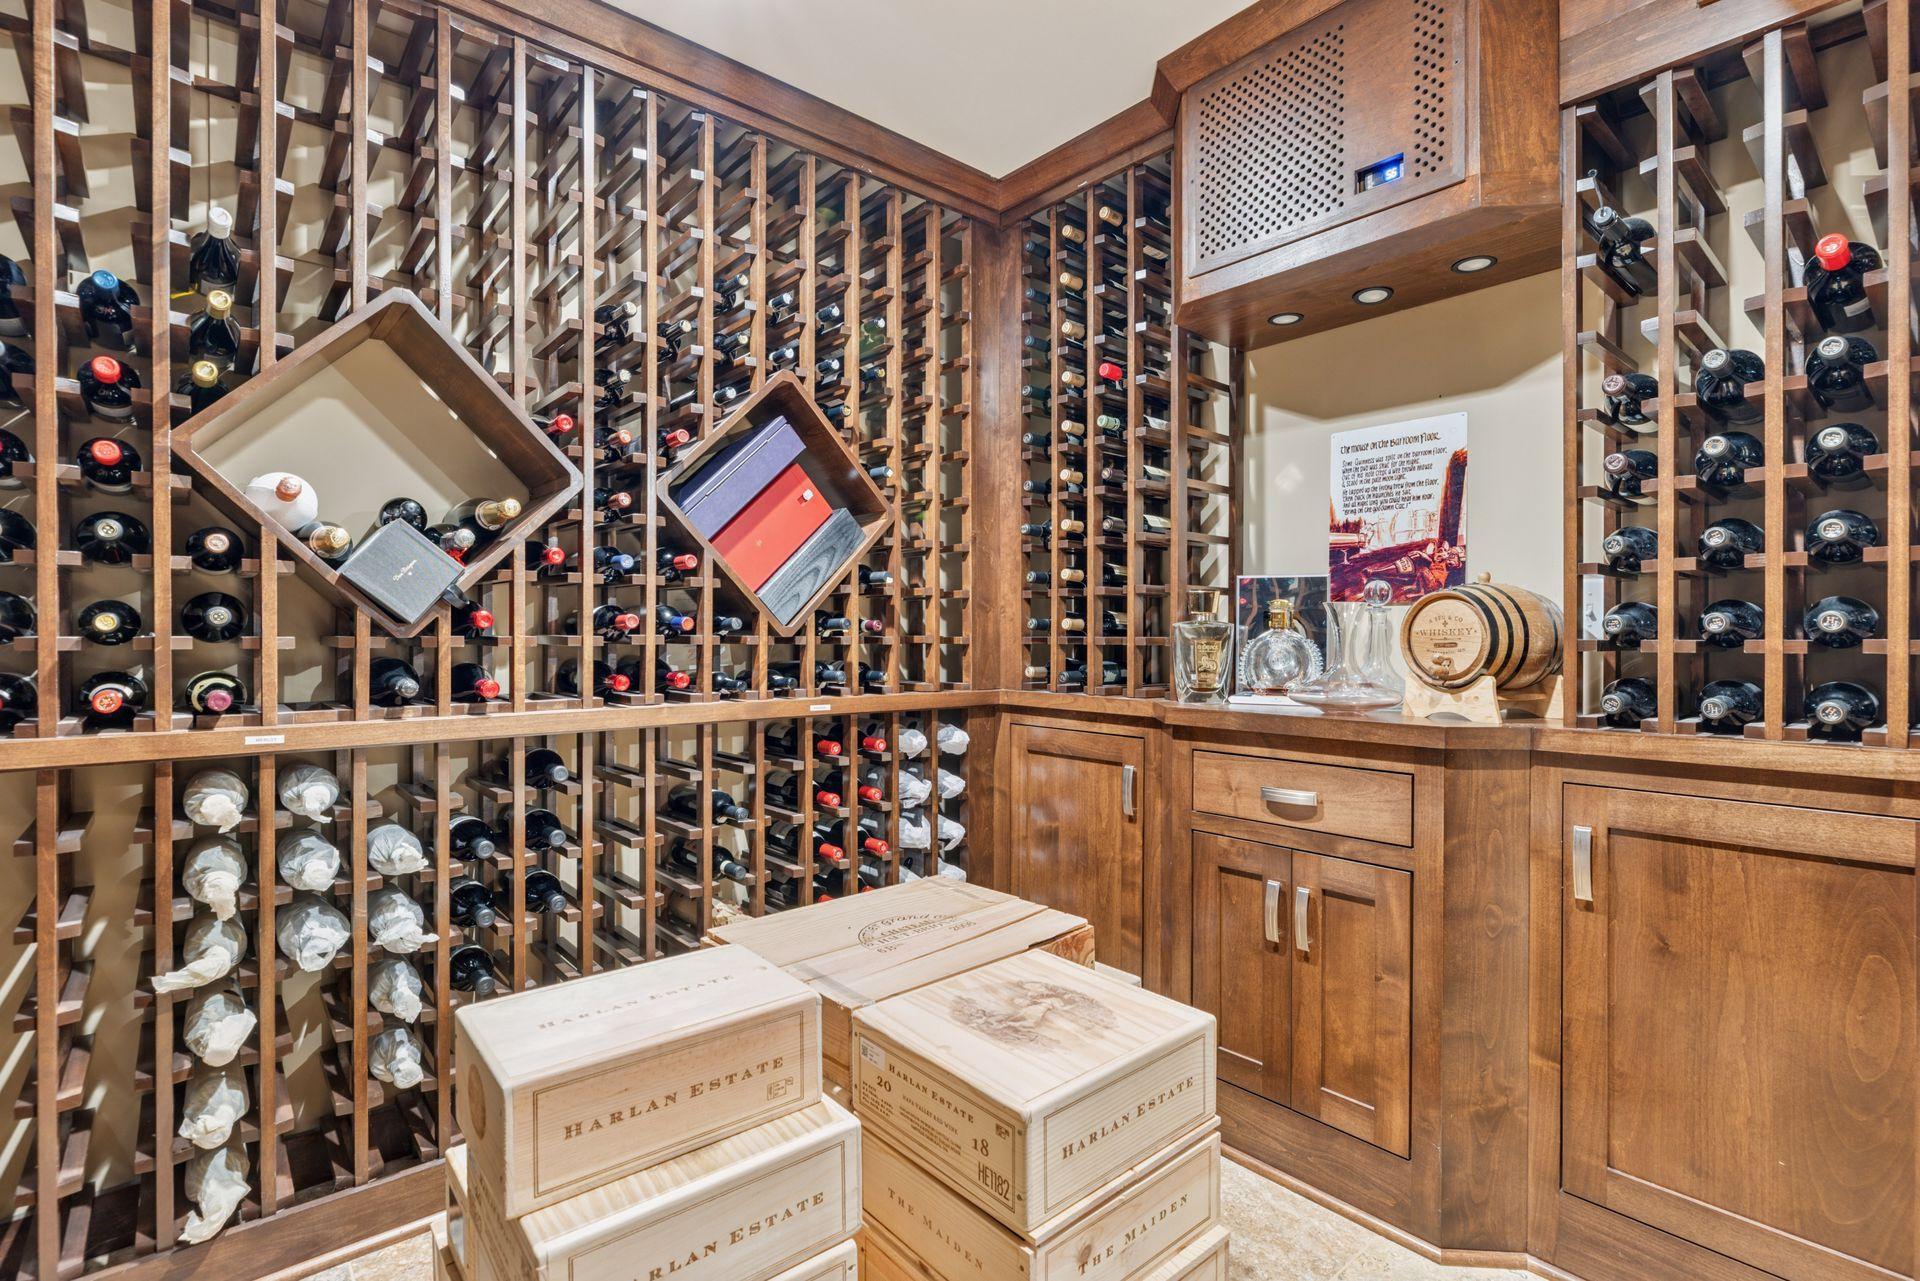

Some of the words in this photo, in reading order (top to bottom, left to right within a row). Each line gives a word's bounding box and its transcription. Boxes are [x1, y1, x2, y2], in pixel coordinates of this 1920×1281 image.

[1355, 457, 1374, 466] Guinness
[1370, 441, 1377, 450] on
[1389, 496, 1400, 504] could
[1420, 628, 1472, 636] WHISKEY
[564, 1091, 678, 1140] HARLAN
[689, 1056, 784, 1099] ESTATE
[876, 1075, 892, 1092] 20
[889, 1063, 928, 1094] HARLAN
[932, 1090, 974, 1124] ESTATE
[1062, 1112, 1131, 1160] HARLAN
[1136, 1076, 1194, 1118] ESTATE
[972, 1138, 990, 1158] 18
[634, 1240, 718, 1281] RLAN
[728, 1192, 824, 1246] ESTATE
[888, 1187, 915, 1216] THE
[922, 1216, 984, 1272] MAIDEN
[1078, 1245, 1114, 1276] THE
[1124, 1194, 1188, 1245] MAIDEN
